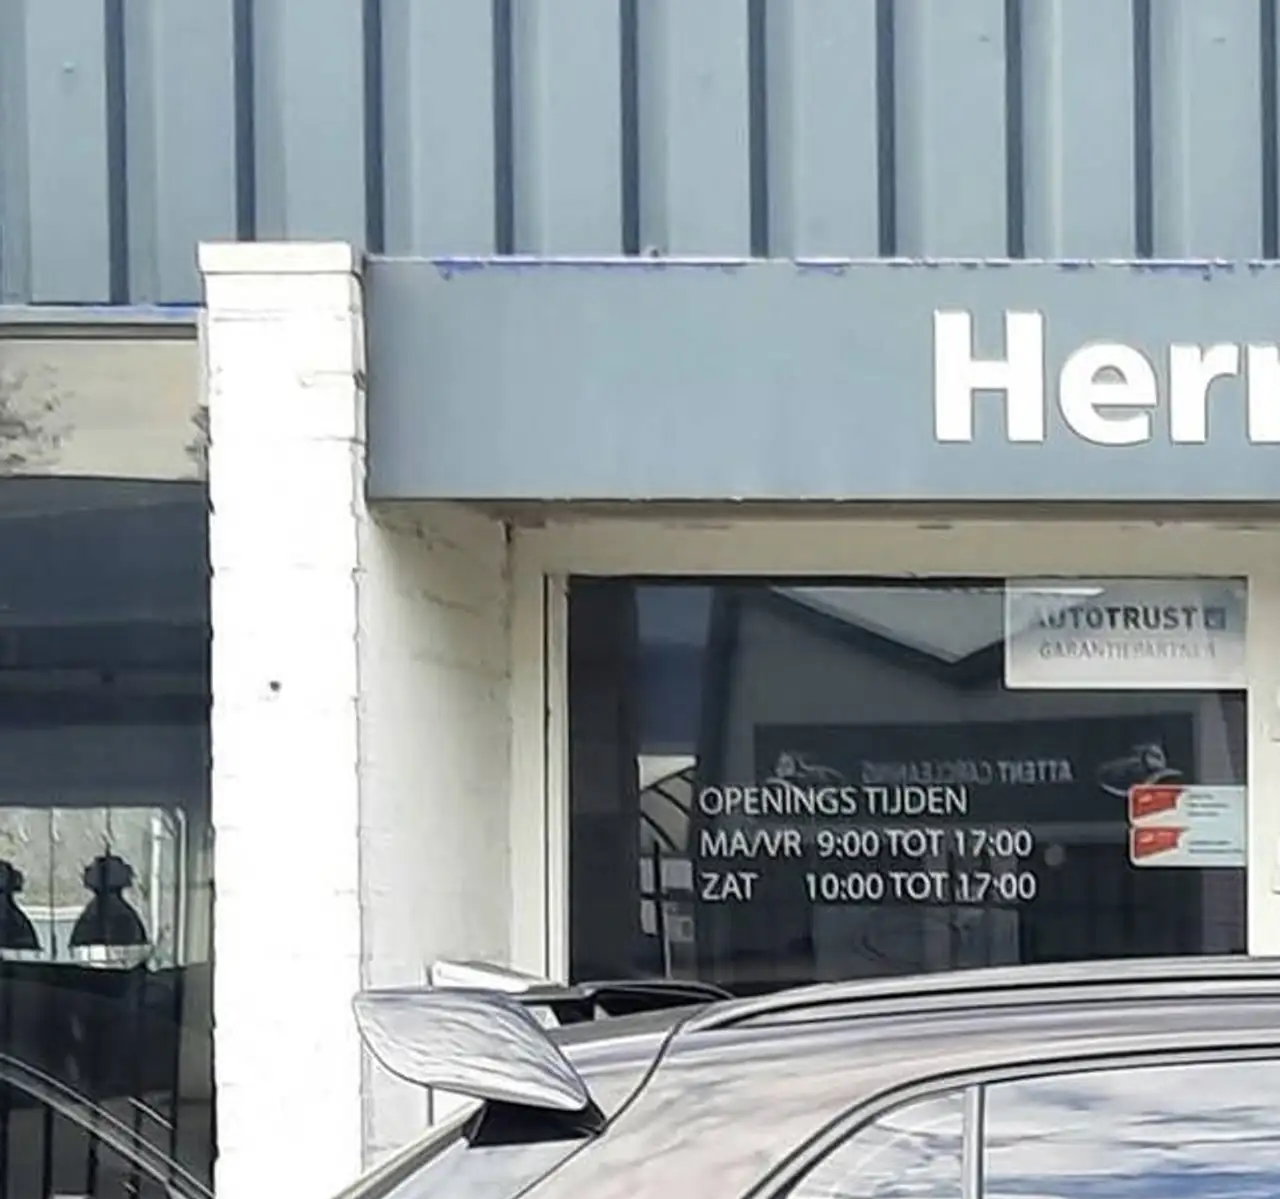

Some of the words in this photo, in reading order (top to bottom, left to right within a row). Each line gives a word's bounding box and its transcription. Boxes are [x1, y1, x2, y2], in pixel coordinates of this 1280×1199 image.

[699, 785, 859, 816] OPENINGS
[862, 785, 968, 816] TIJDEN
[700, 828, 803, 857] MA/VR
[815, 828, 881, 858] 9:00
[885, 828, 944, 858] TOT
[953, 828, 1034, 858] 17:00
[701, 871, 760, 902] ZAT
[805, 871, 885, 902] 10:00
[888, 871, 949, 902] TOT
[956, 871, 1038, 902] 17:00
